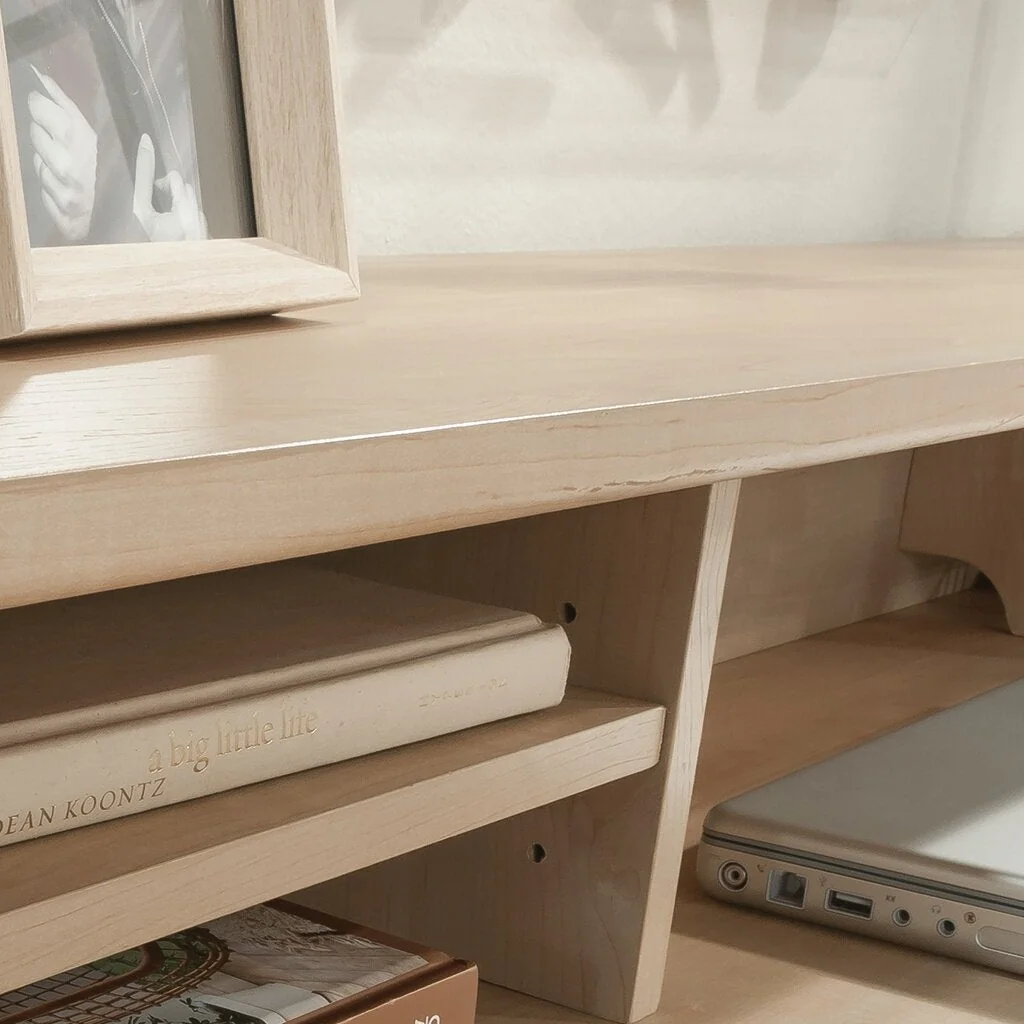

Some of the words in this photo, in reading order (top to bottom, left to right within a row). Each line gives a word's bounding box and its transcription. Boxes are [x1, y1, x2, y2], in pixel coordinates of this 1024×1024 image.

[148, 748, 164, 774] a
[169, 729, 210, 774] big
[215, 711, 275, 757] little
[278, 698, 319, 741] life
[63, 777, 167, 821] KOONTZ
